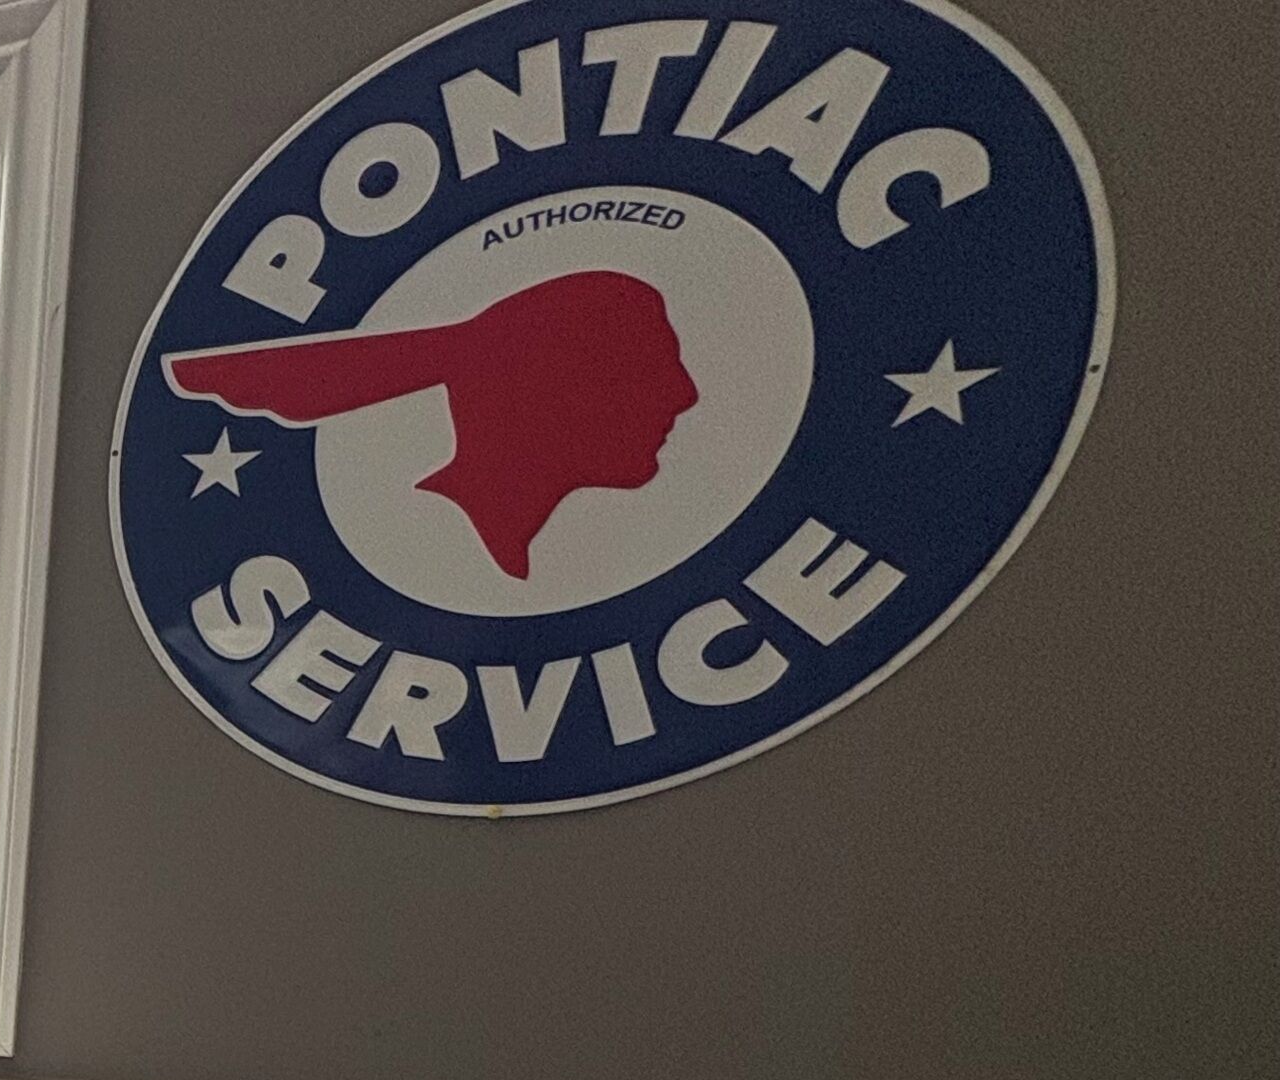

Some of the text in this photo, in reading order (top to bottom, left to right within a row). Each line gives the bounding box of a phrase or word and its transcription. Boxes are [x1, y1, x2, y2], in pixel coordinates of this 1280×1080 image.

[221, 20, 991, 323] PONTIAC
[483, 201, 686, 250] AUTHORIZED
[191, 517, 907, 762] SERVICE
